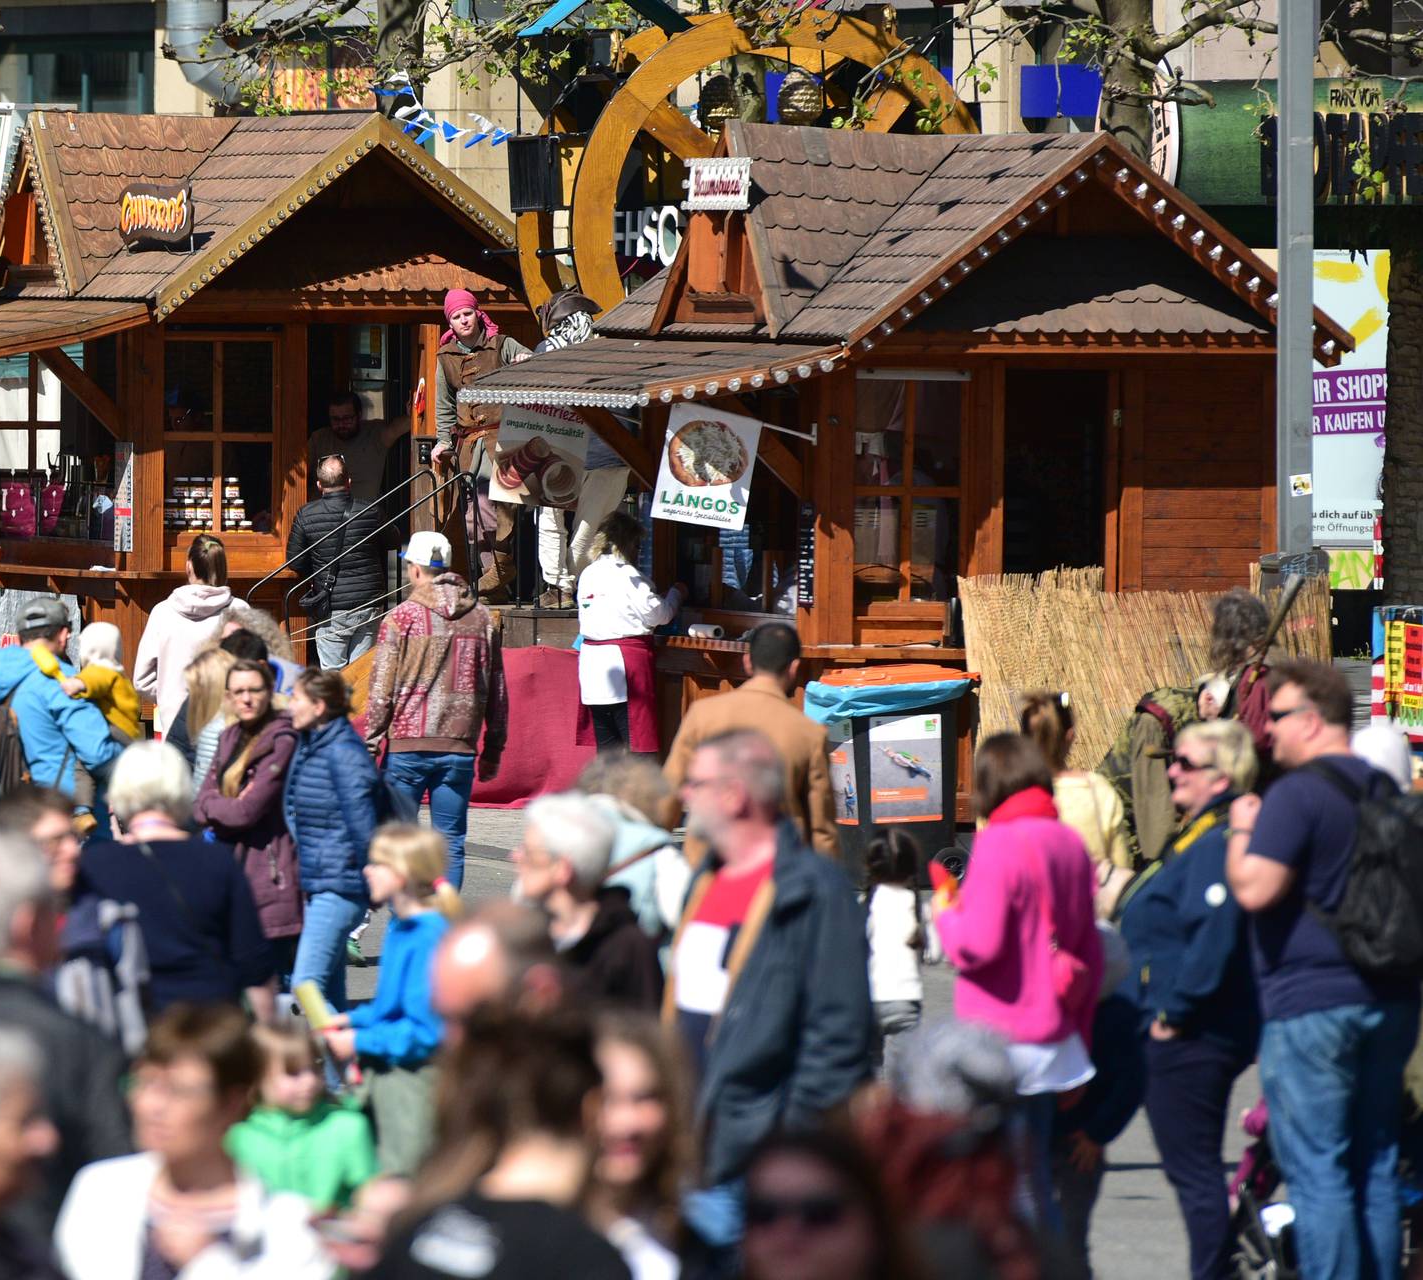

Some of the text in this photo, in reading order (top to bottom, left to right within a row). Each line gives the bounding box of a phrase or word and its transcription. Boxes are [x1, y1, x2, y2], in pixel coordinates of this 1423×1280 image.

[121, 189, 187, 235] CHURROS
[506, 419, 544, 432] ungarische
[1325, 410, 1374, 431] KAUFEN
[660, 490, 740, 515] LÁNGOS
[1319, 510, 1340, 519] dich
[1341, 511, 1359, 519] auf
[1360, 510, 1373, 520] üb
[1327, 522, 1373, 533] Öffnungsz
